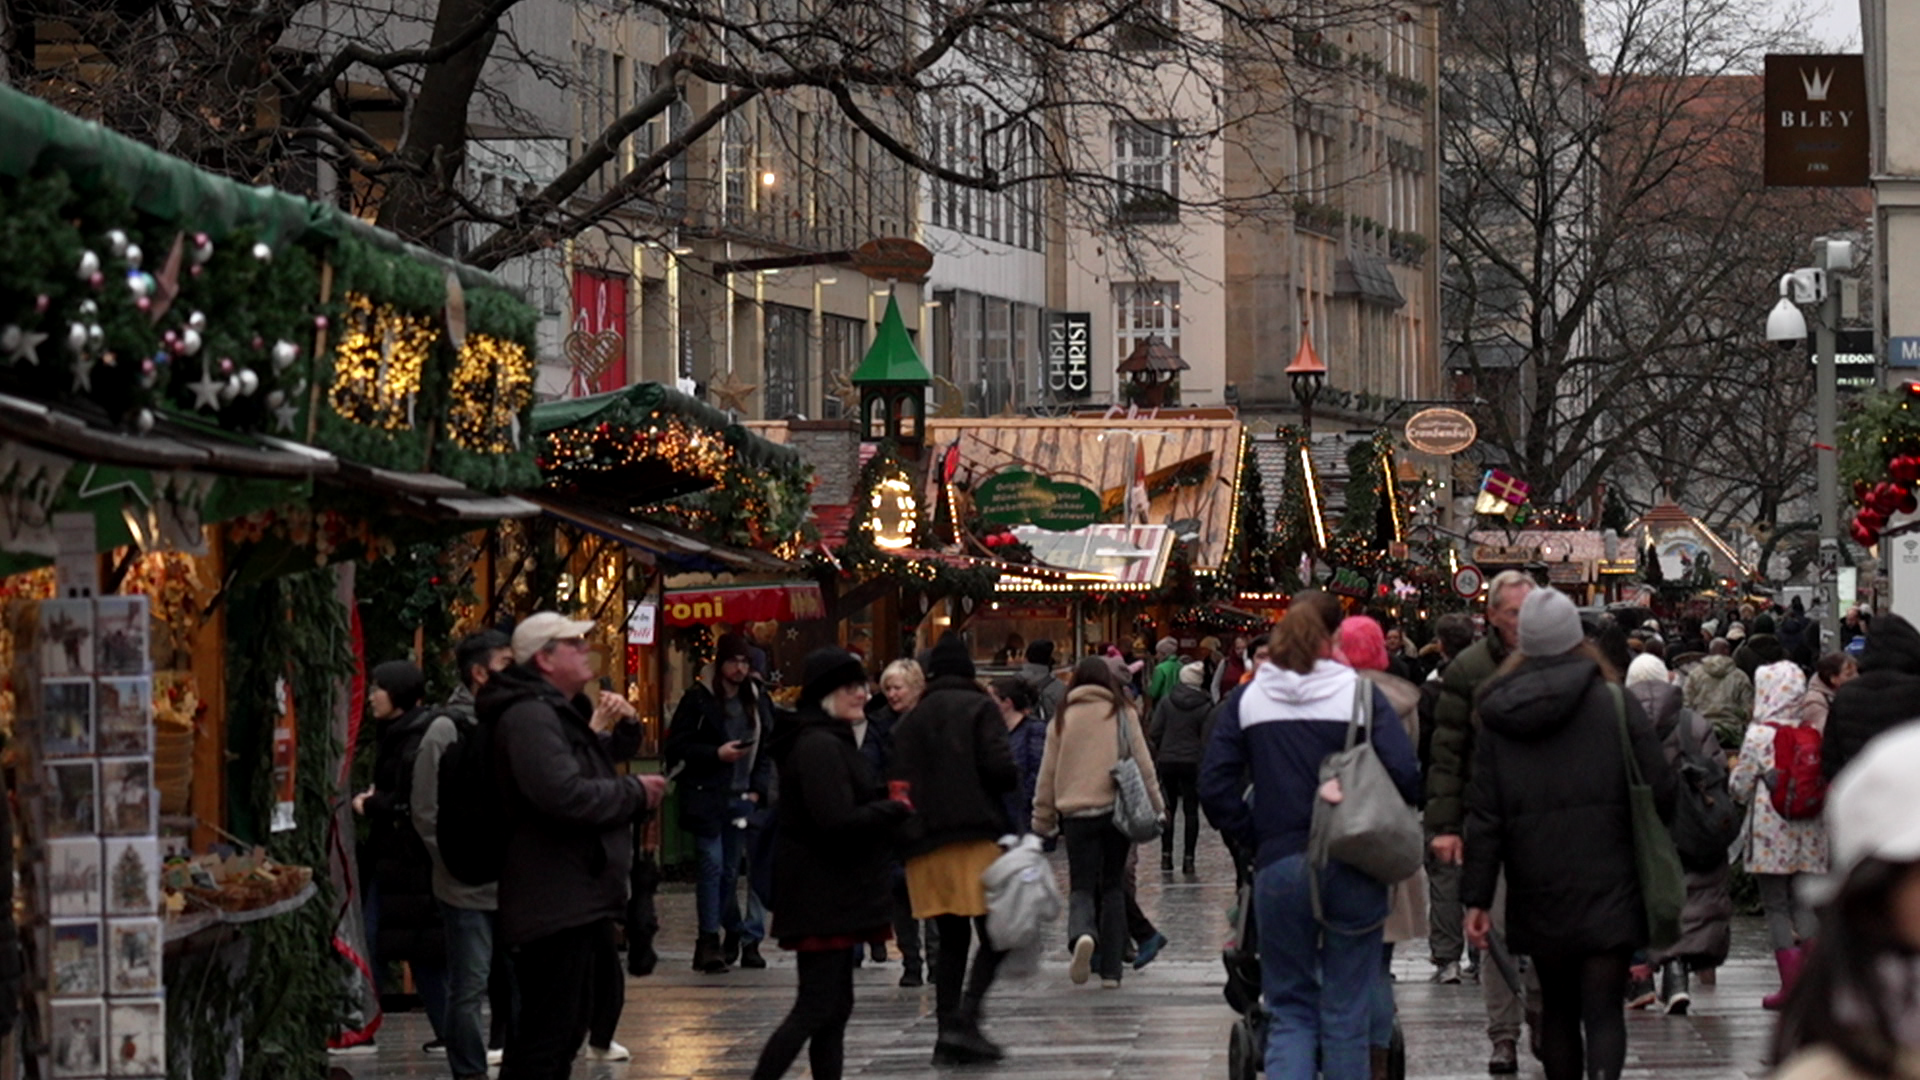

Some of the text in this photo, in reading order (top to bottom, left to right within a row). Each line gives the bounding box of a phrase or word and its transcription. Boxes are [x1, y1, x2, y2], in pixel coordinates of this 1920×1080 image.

[1781, 110, 1854, 128] BLEY
[1068, 320, 1088, 391] CHRIST
[1901, 340, 1920, 359] M
[664, 596, 723, 620] oni
